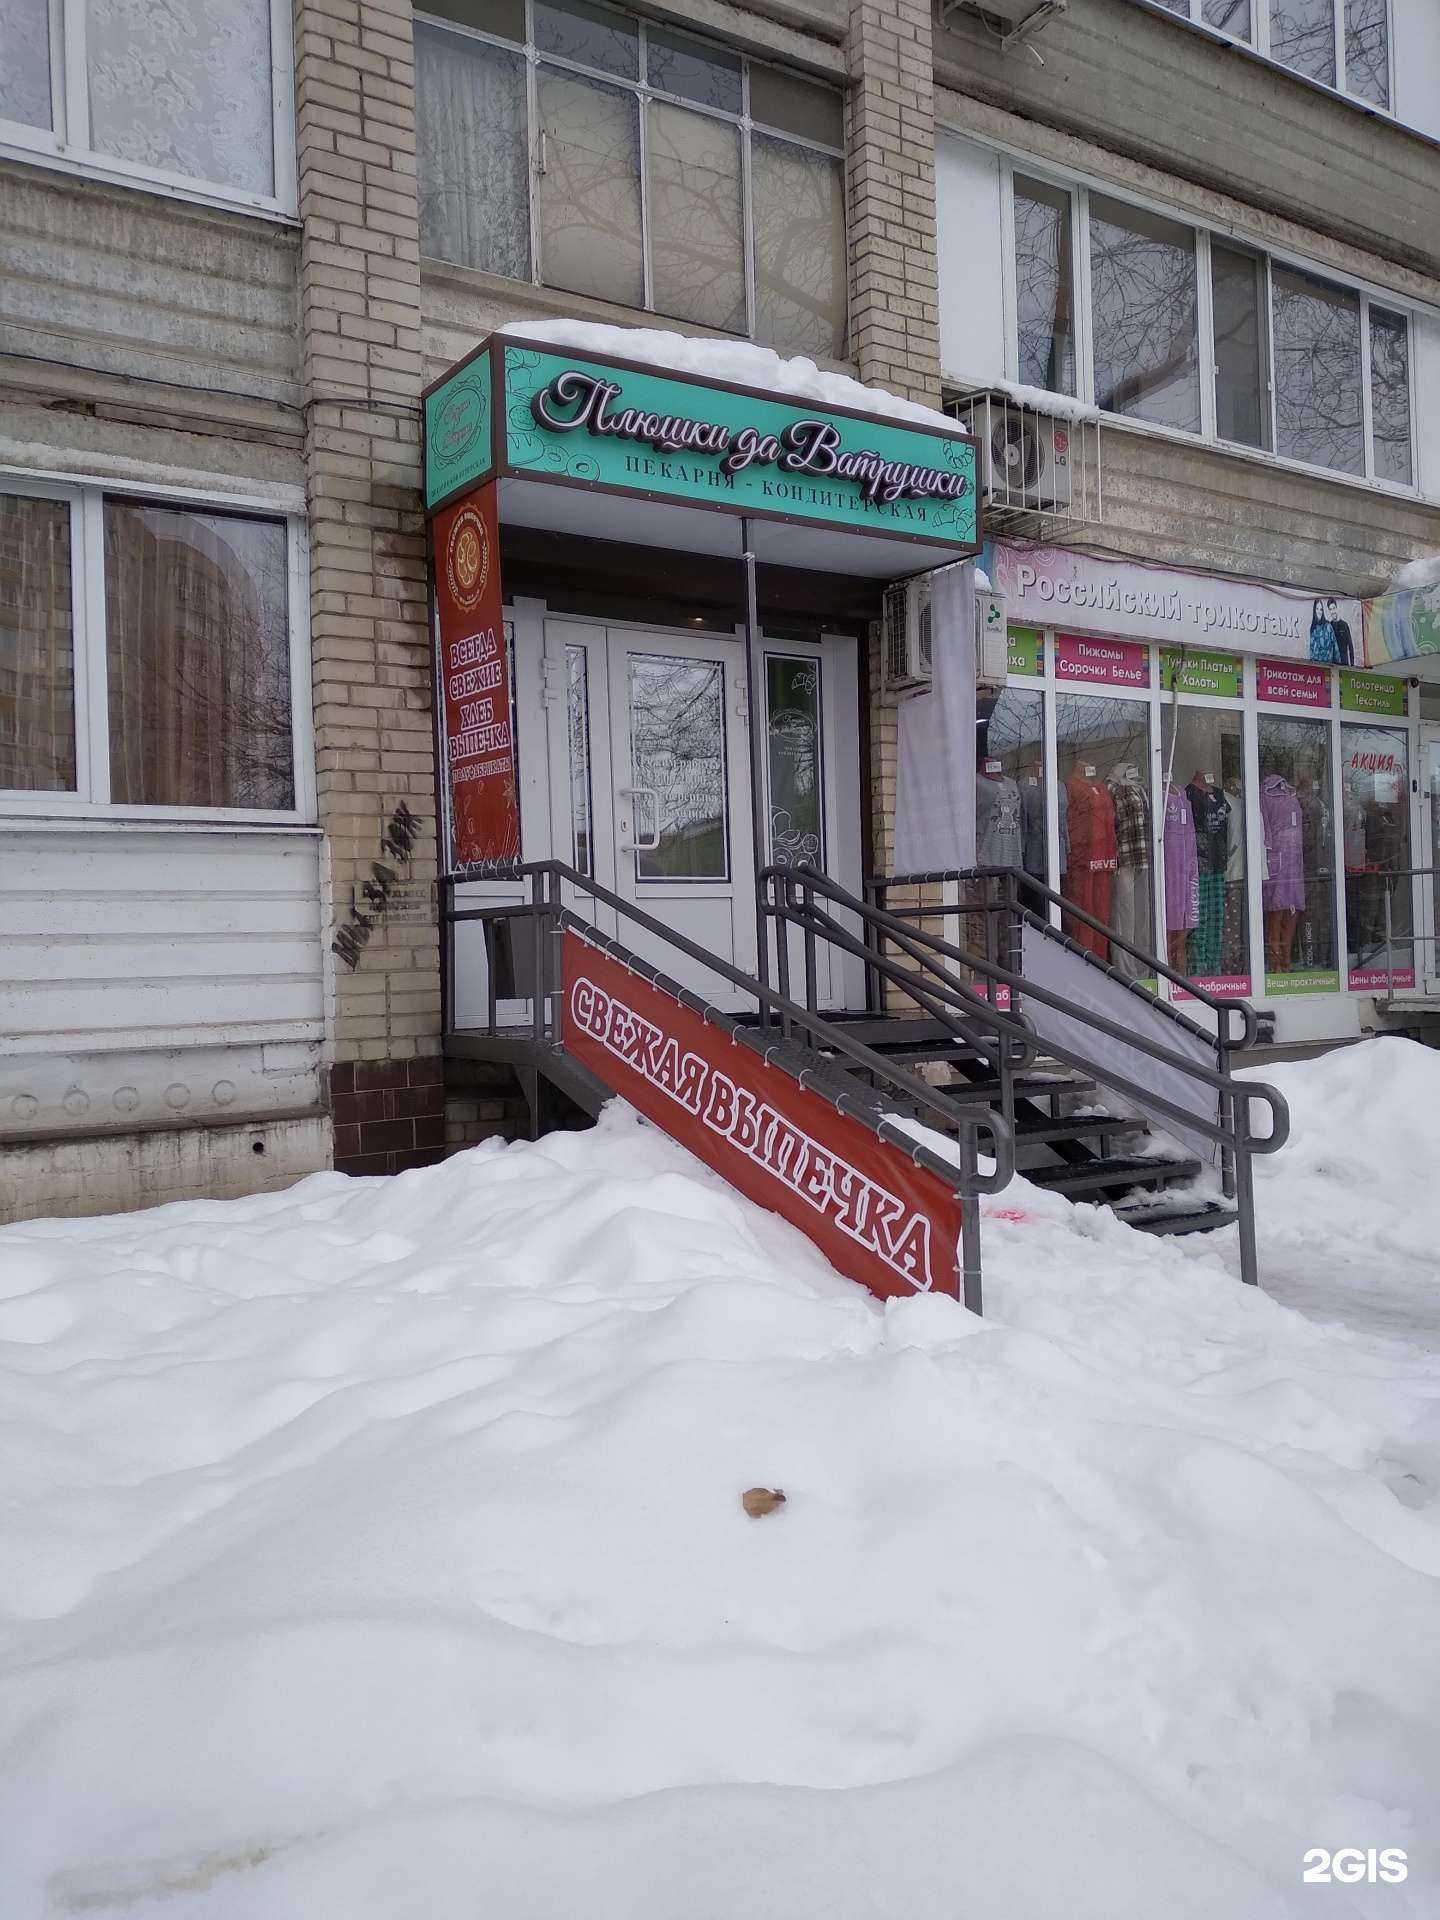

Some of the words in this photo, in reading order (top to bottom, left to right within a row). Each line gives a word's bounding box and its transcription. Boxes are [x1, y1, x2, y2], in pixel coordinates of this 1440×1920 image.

[535, 370, 731, 453] Плюшки
[725, 426, 782, 472] да
[782, 419, 968, 502] Ватрушки
[625, 455, 735, 490] ПЕКАРНЯ
[762, 479, 927, 522] КОНДИТЕРСКАЯ
[1016, 563, 1182, 620] Российский
[1187, 601, 1301, 639] трикотаж
[450, 628, 496, 669] ВСЕГДА
[1078, 643, 1124, 661] Пижамы
[1060, 659, 1107, 676] Сорочки
[1112, 665, 1142, 680] Белье
[1201, 659, 1233, 673] Платья
[1262, 667, 1305, 683] Трикотаж
[1307, 674, 1322, 684] для
[450, 660, 502, 700] СВЕЖИЕ
[1182, 674, 1219, 689] Халаты
[1267, 685, 1289, 696] всей
[1291, 688, 1318, 699] семьи
[1355, 694, 1391, 708] Текстиль
[460, 698, 494, 731] ХЛЕБ
[449, 722, 511, 761] ВЫПЕЧКА
[1351, 752, 1395, 772] АКЦИЯ
[1350, 975, 1369, 985] Цены
[571, 977, 709, 1116] СВЕЖАЯ
[703, 1071, 933, 1292] ВЫПЕЧКА
